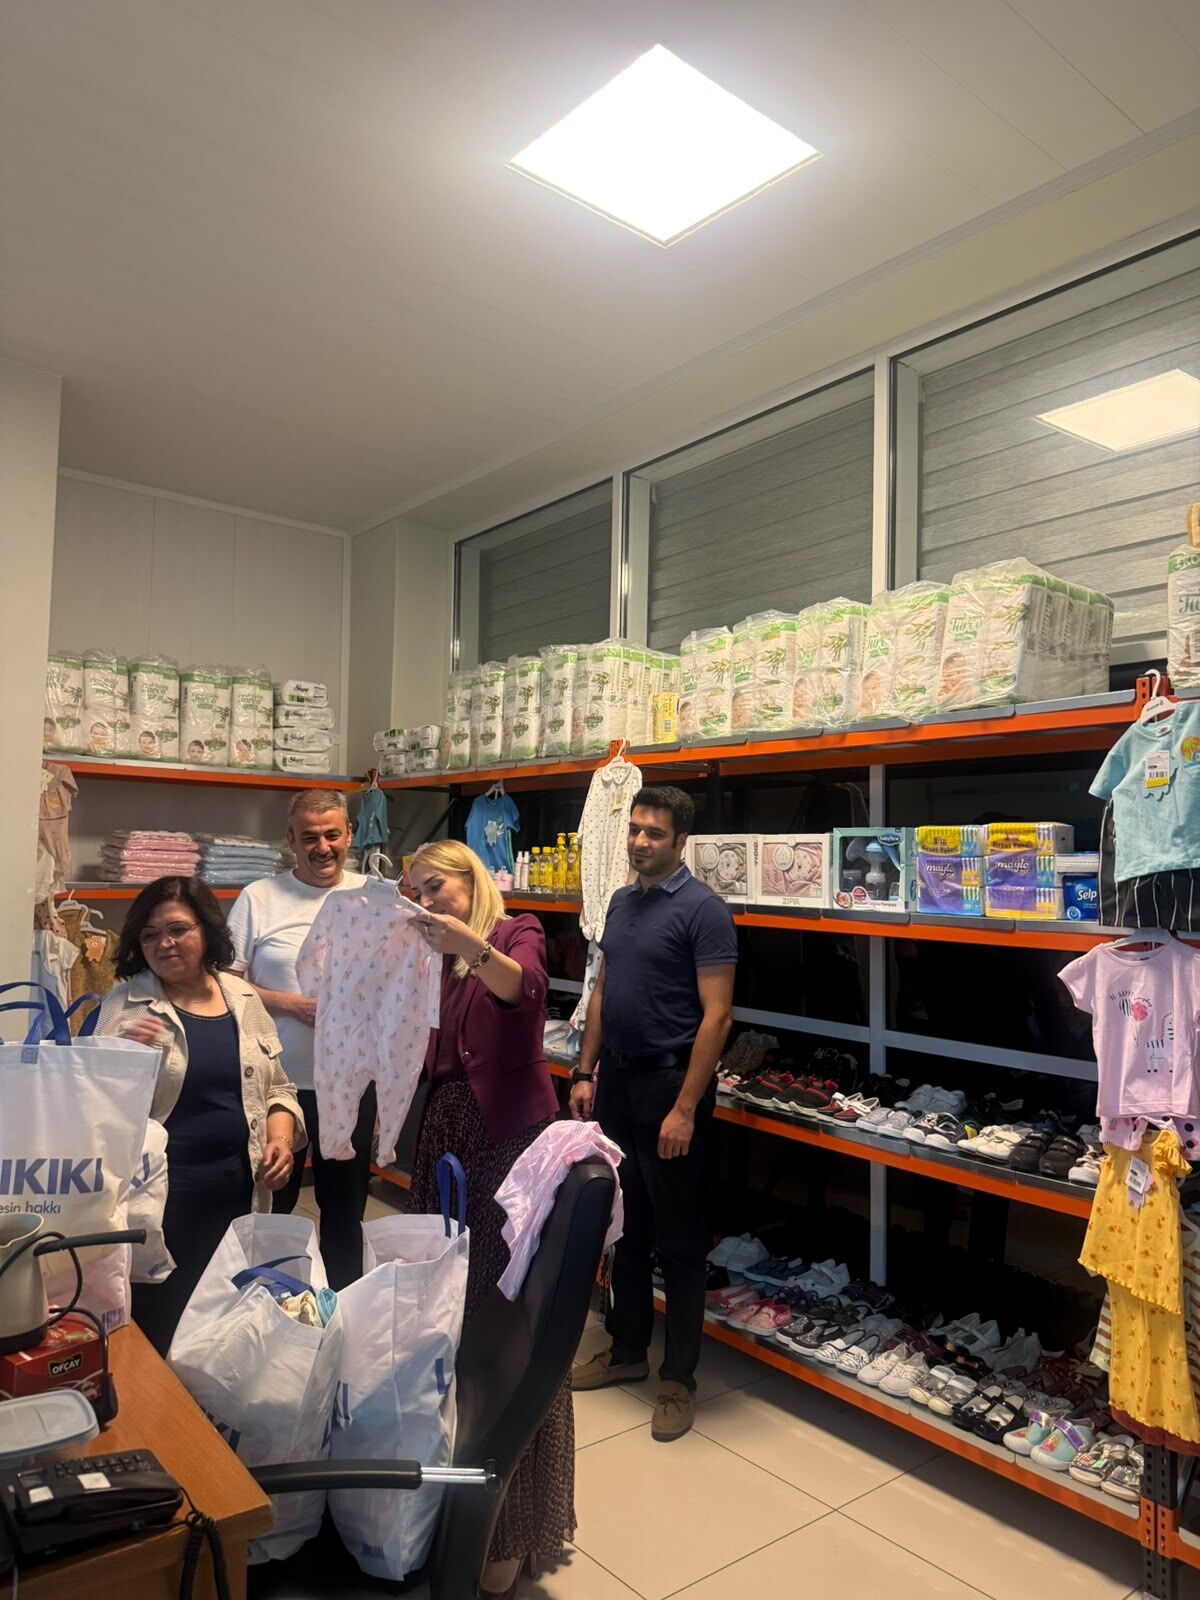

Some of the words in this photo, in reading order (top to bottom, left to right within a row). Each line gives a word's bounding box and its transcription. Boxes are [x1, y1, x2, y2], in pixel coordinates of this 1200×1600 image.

[926, 863, 955, 875] maylo
[997, 859, 1029, 872] maylo
[25, 1200, 61, 1215] hakkı
[52, 1359, 80, 1374] OFÇAY
